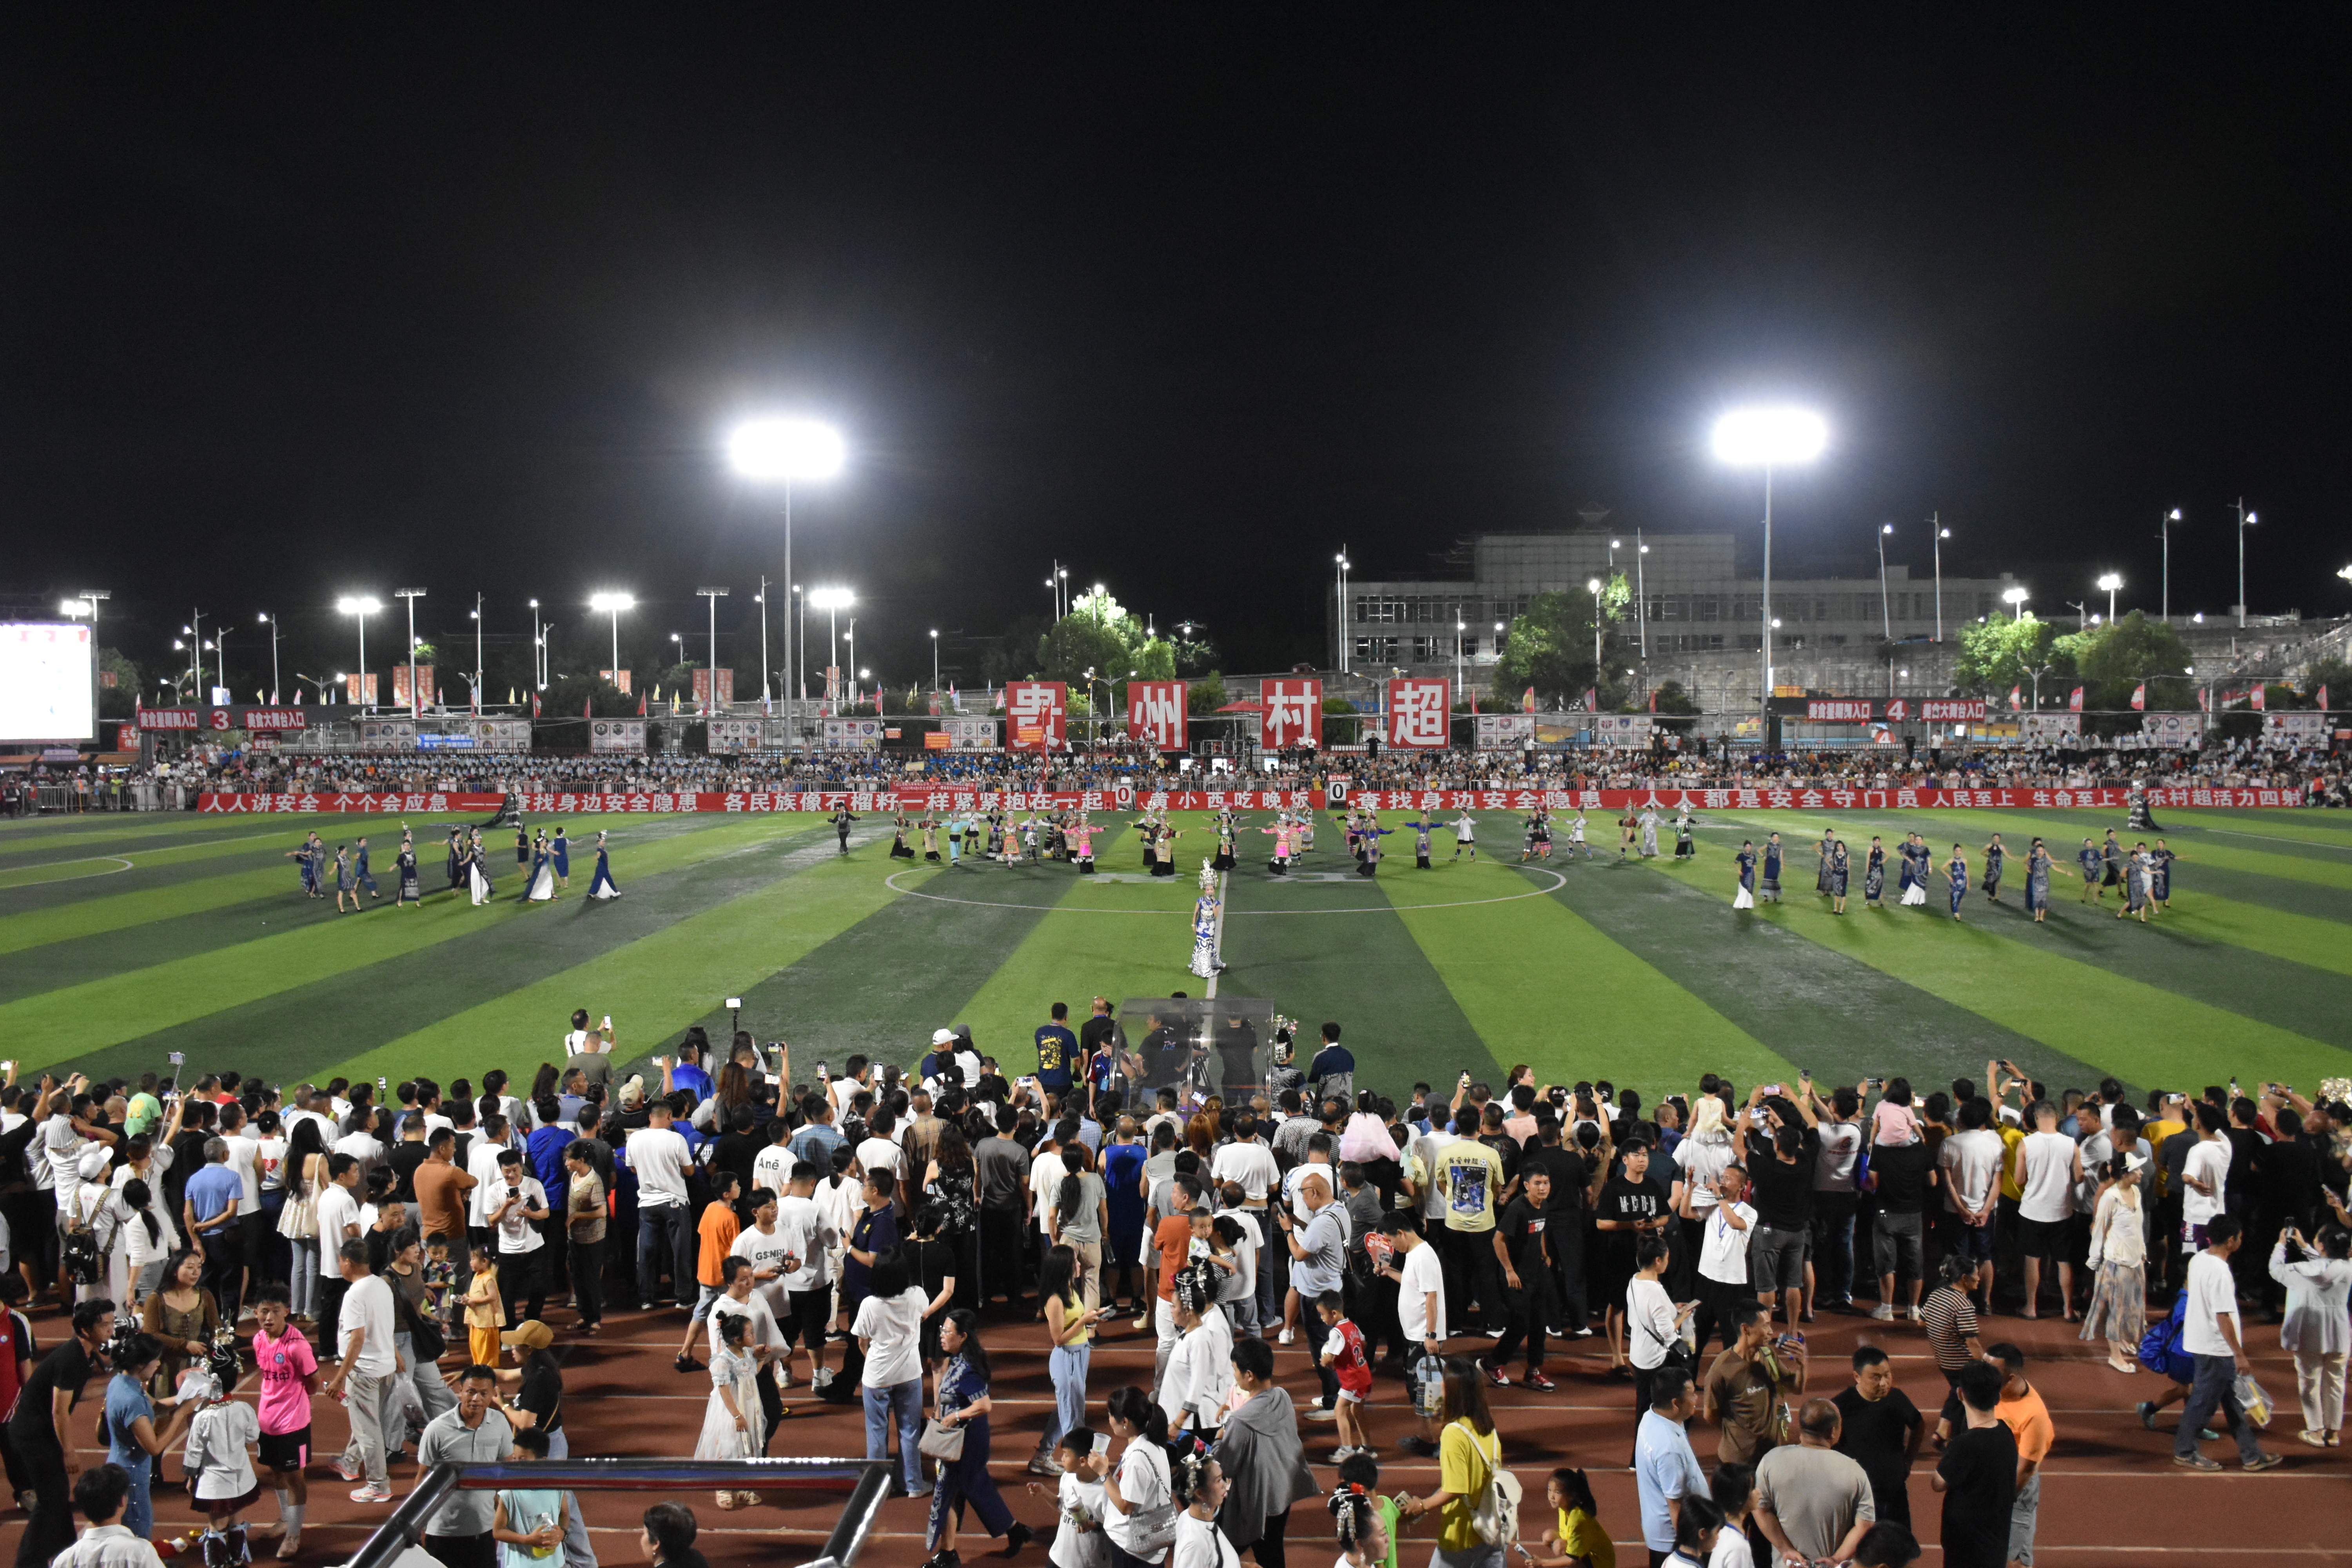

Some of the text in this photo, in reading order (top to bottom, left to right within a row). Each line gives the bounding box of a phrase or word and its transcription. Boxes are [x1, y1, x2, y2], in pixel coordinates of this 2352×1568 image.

[214, 710, 229, 730] 3
[1010, 682, 1445, 748] 贵 州 村 超
[1888, 701, 1905, 720] 4
[1118, 788, 1129, 802] 0
[1332, 783, 1343, 799] 0
[204, 793, 320, 813] 人人讲安全
[333, 793, 449, 812] 个个会应急
